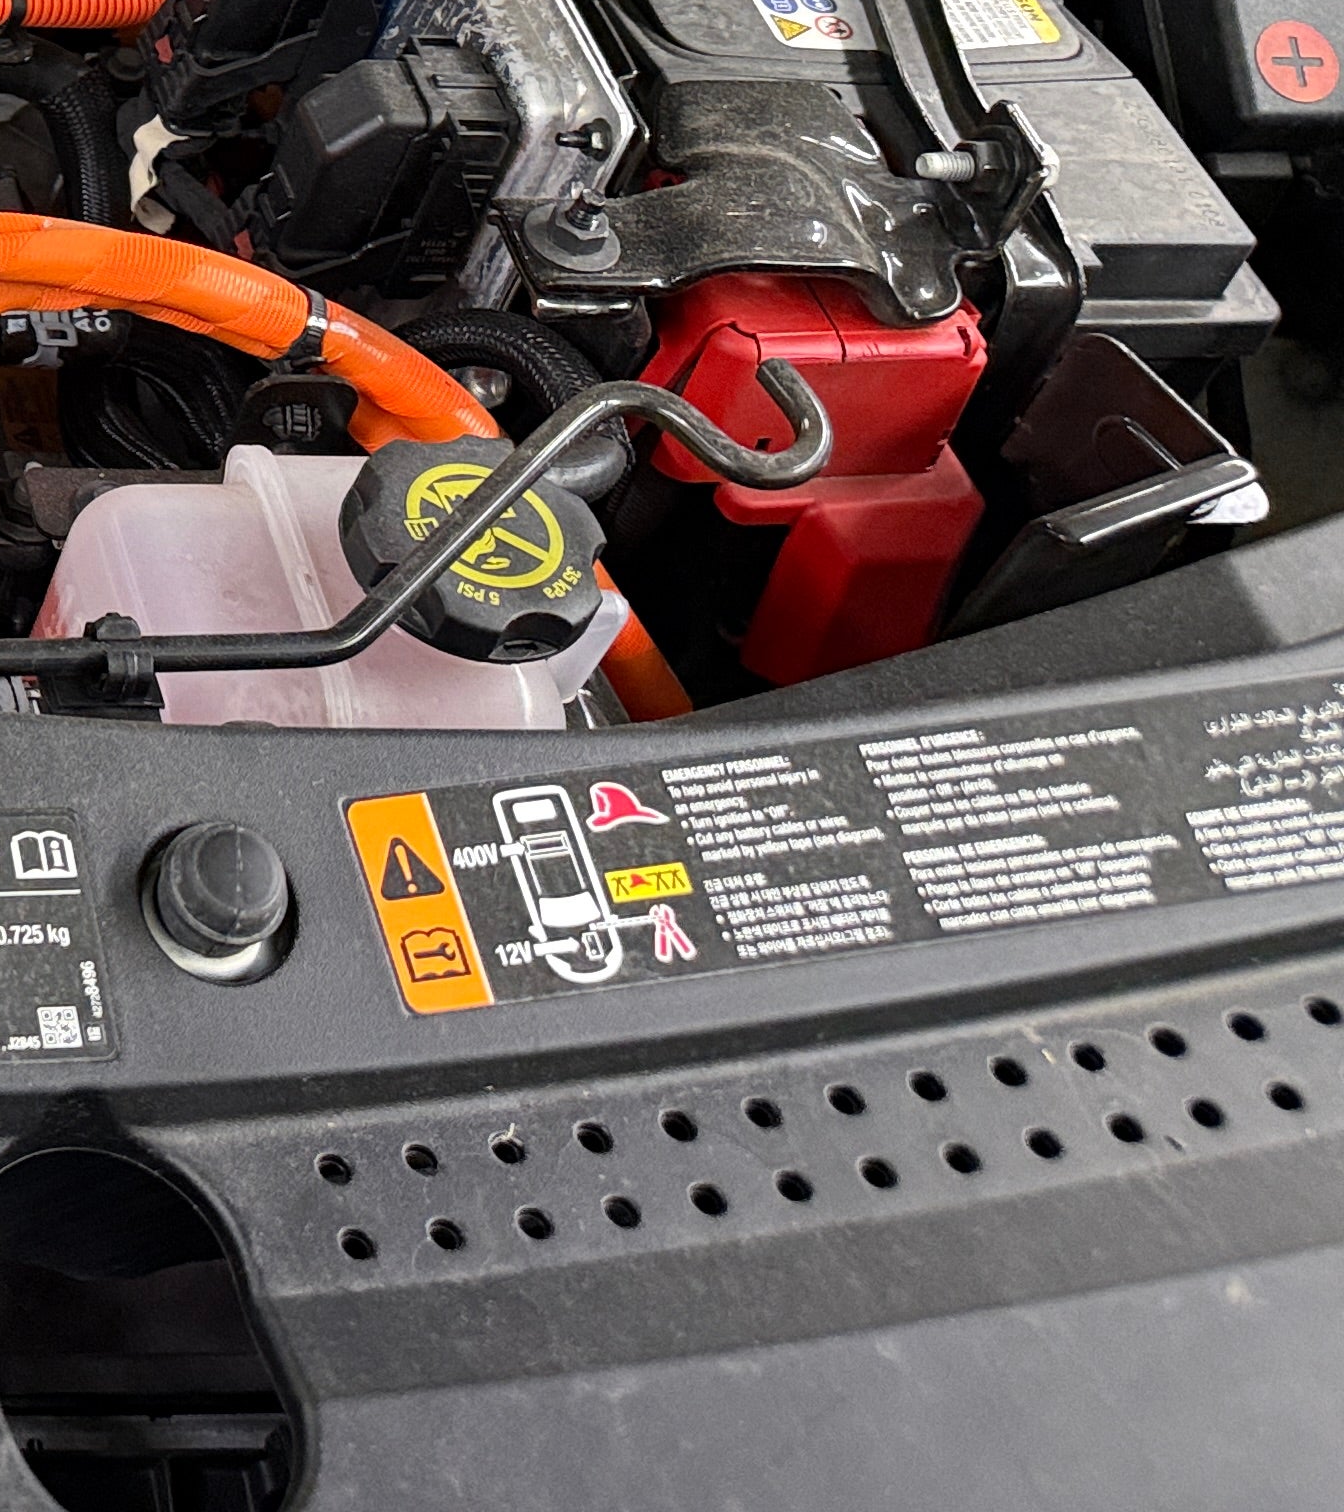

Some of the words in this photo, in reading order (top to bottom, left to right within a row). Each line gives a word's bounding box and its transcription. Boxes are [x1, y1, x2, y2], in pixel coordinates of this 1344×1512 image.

[563, 565, 583, 586] 35
[457, 581, 487, 602] PSI
[489, 592, 501, 606] 5
[542, 579, 570, 599] kPa
[661, 762, 726, 783] EMERGENCY
[667, 785, 682, 799] To
[680, 782, 706, 799] help
[704, 778, 735, 794] avoid
[732, 773, 779, 792] personal
[777, 770, 809, 787] injury
[673, 804, 689, 814] an
[688, 815, 713, 829] Turn
[711, 809, 752, 828] ignition
[695, 832, 715, 846] Cut
[714, 830, 735, 845] any
[733, 824, 771, 843] battery
[770, 820, 806, 836] cables
[817, 813, 849, 829] wires
[453, 843, 499, 871] 400V
[700, 846, 741, 863] marked
[740, 844, 756, 859] by
[754, 838, 790, 857] yellow
[788, 835, 814, 851] tape
[811, 832, 837, 848] (see
[46, 924, 71, 947] kg
[494, 940, 534, 968] 12V
